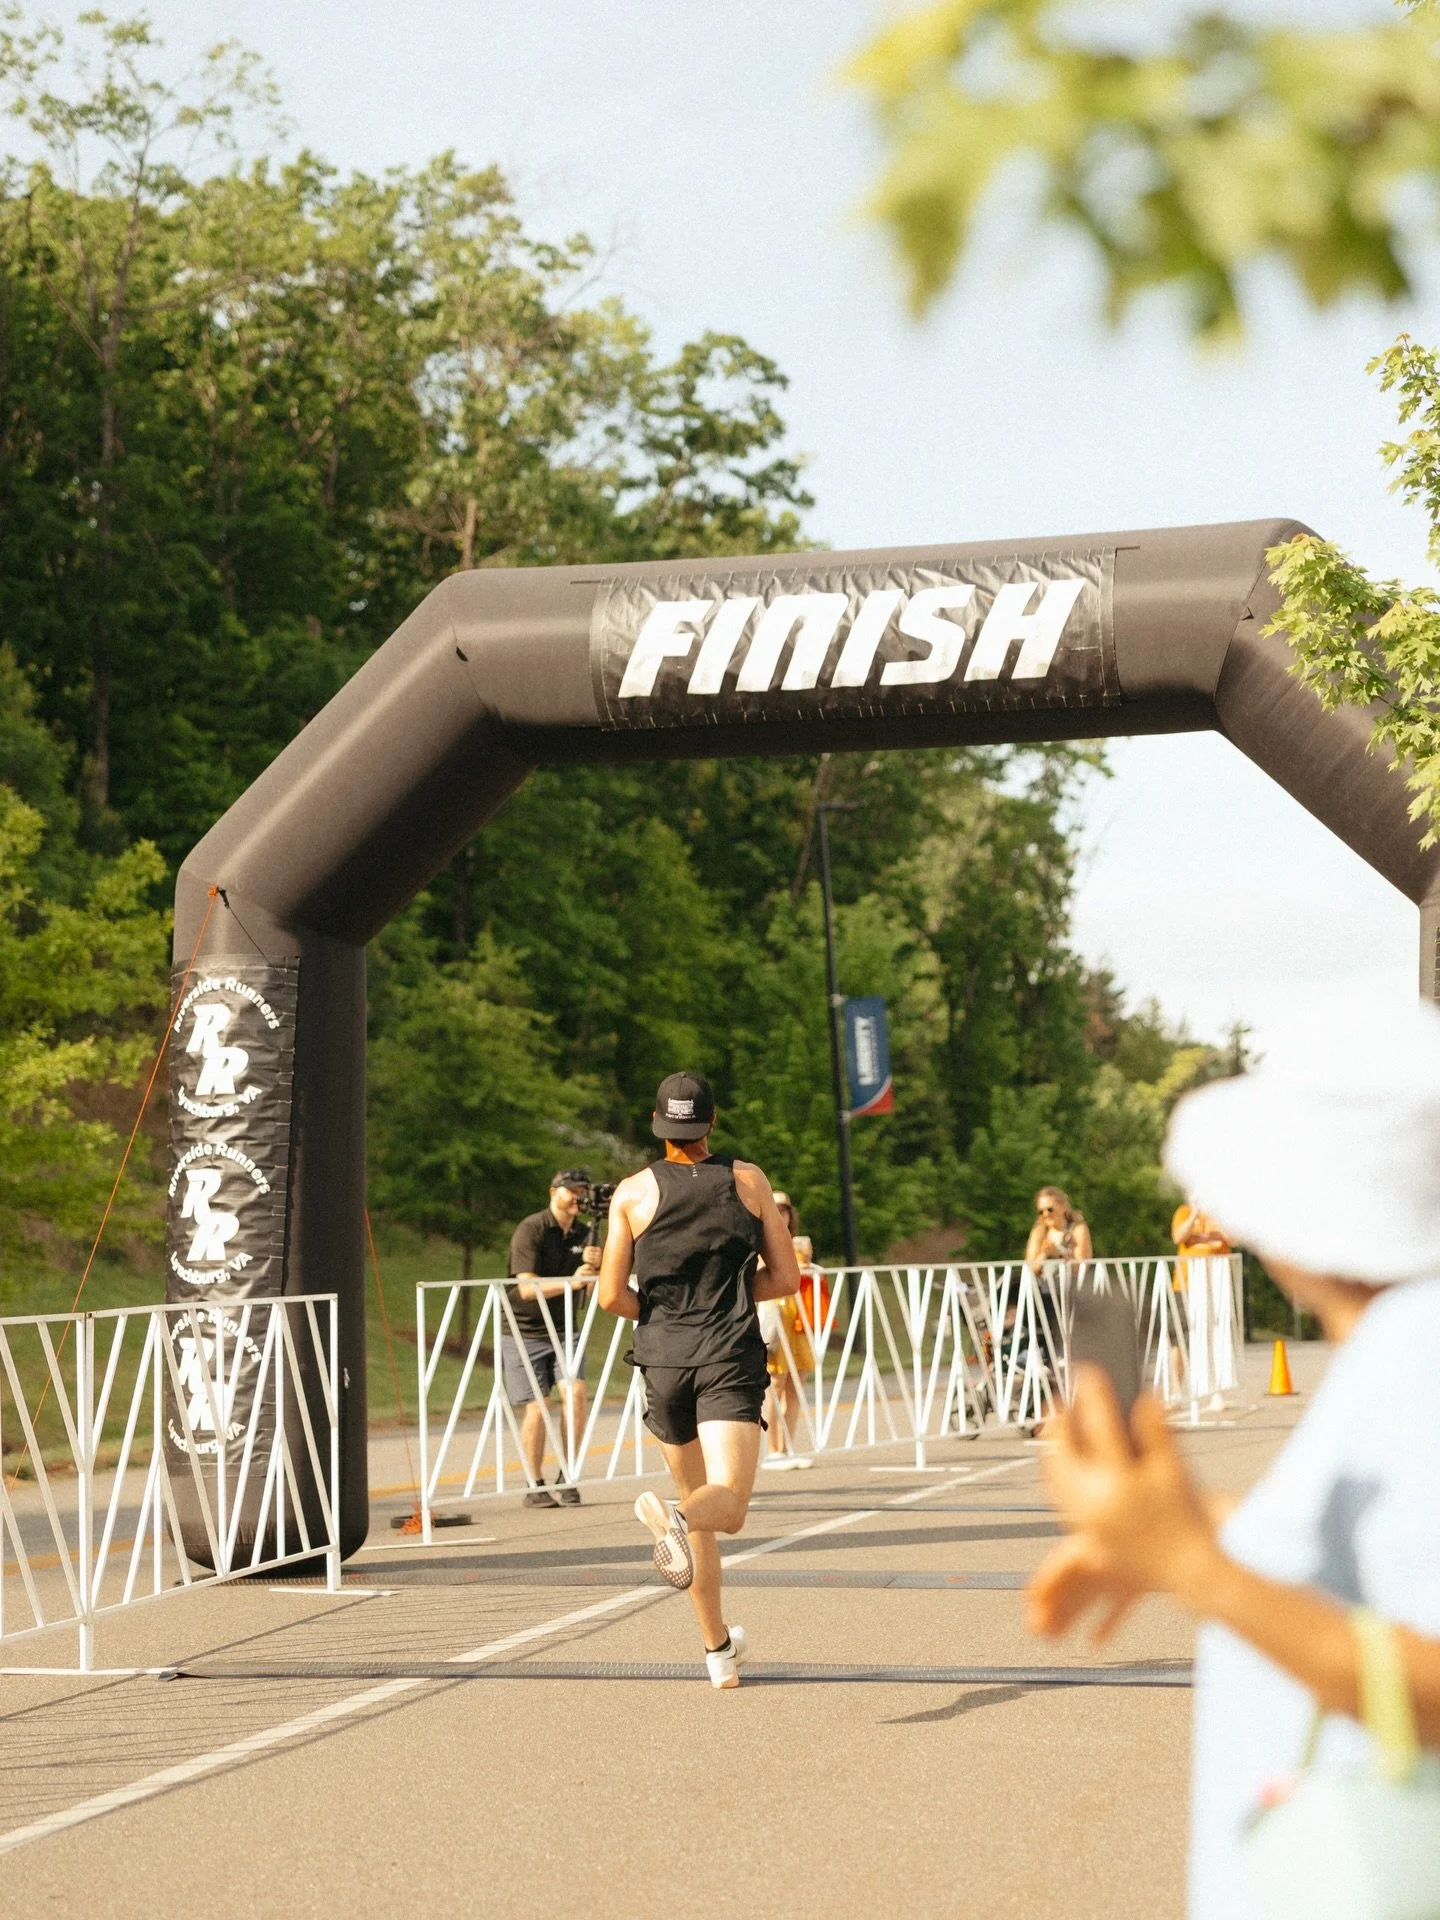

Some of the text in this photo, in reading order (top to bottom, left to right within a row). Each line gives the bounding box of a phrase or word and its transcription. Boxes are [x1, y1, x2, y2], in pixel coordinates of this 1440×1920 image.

[617, 578, 1086, 698] FINISH
[224, 976, 280, 1030] Runners
[237, 1085, 263, 1105] VA
[215, 1142, 271, 1194] Runners
[227, 1252, 254, 1272] VA
